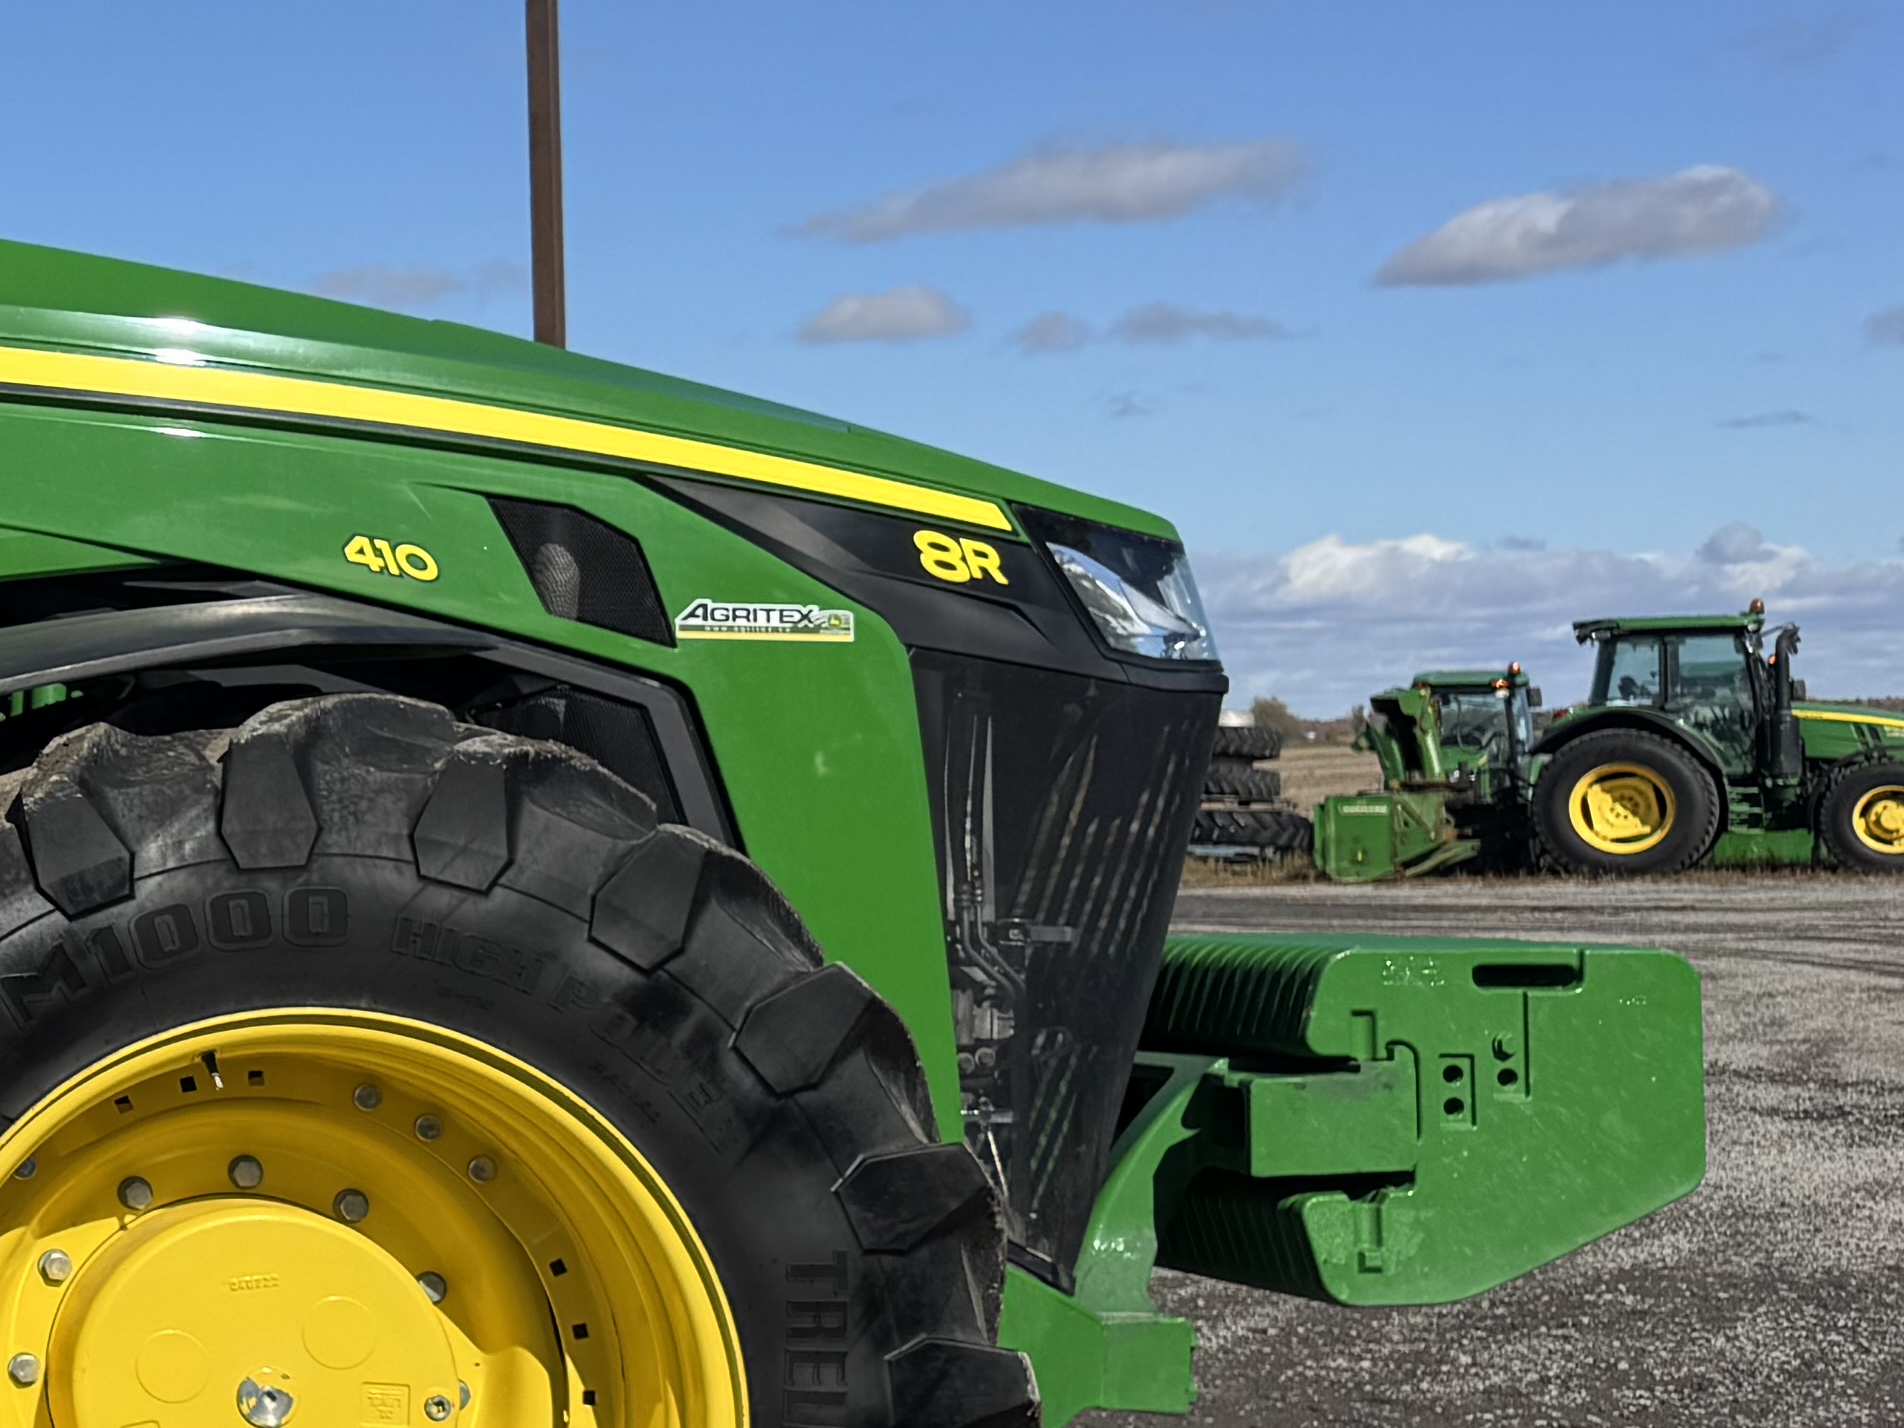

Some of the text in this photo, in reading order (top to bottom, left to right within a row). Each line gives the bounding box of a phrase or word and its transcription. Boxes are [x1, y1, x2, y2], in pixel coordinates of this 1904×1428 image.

[342, 533, 440, 582] 410
[912, 529, 1010, 586] 8R
[680, 602, 815, 625] AGRITEX
